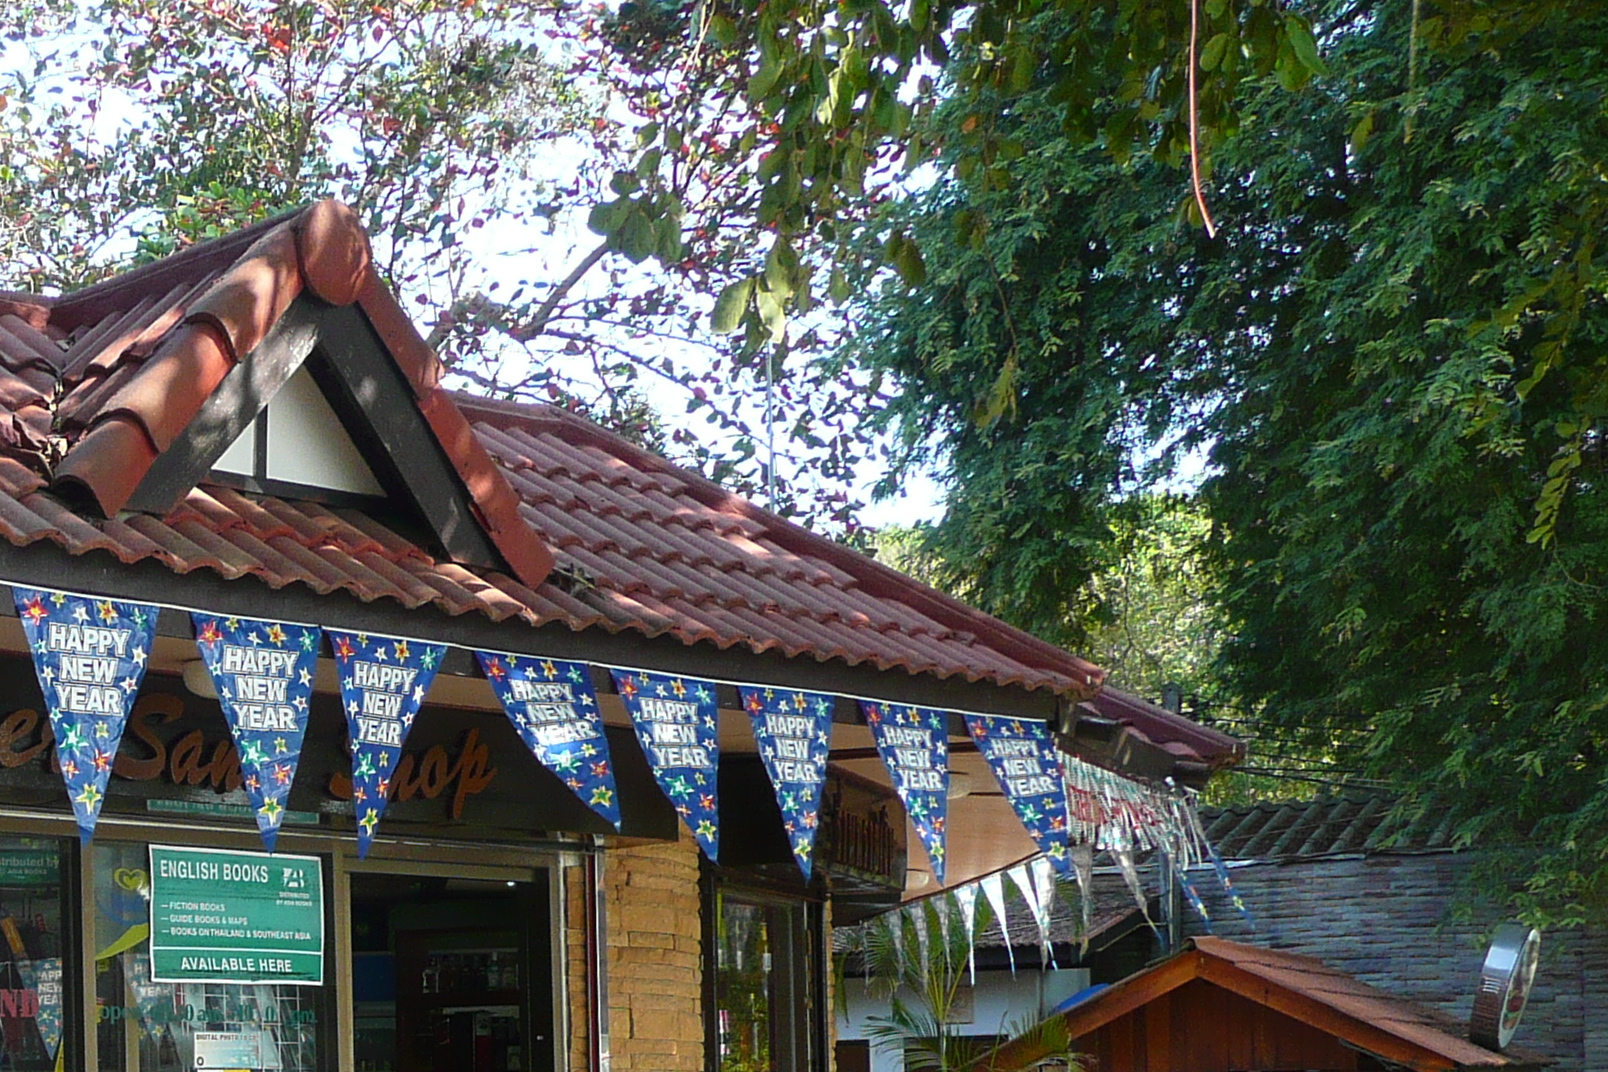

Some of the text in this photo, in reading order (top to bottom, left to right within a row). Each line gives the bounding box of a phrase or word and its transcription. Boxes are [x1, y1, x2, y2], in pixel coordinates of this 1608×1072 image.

[47, 622, 131, 657] HAPPY
[59, 655, 119, 685] NEW
[222, 645, 300, 678] HAPPY
[352, 661, 418, 694] HAPPY
[54, 683, 123, 716] YEAR
[235, 676, 288, 704] NEW
[508, 679, 576, 703] HAPPY
[232, 702, 299, 732] YEAR
[361, 691, 402, 719] NEW
[525, 700, 579, 722] NEW
[638, 698, 699, 725] HAPPY
[355, 717, 402, 747] YEAR
[527, 720, 600, 747] YEAR
[652, 723, 697, 745] NEW
[765, 714, 815, 738] HAPPY
[882, 724, 932, 748] HAPPY
[113, 692, 245, 793] San
[775, 738, 810, 760] NEW
[991, 738, 1039, 756] HAPPY
[651, 744, 712, 769] YEAR
[895, 748, 930, 770] NEW
[1002, 757, 1042, 776] NEW
[773, 759, 821, 783] YEAR
[896, 768, 946, 791] YEAR
[1005, 776, 1057, 797] YEAR
[160, 859, 269, 884] ENGLISH BOOKS
[169, 902, 226, 912] FICTION BOOKS
[169, 915, 193, 923] GUIDE
[194, 916, 220, 924] BOOKS
[171, 927, 197, 936] BOOKS
[253, 930, 293, 940] SOUTHEAST
[294, 931, 312, 940] ASIA
[37, 971, 62, 982] APP
[181, 957, 292, 973] AVAILABLE HERE
